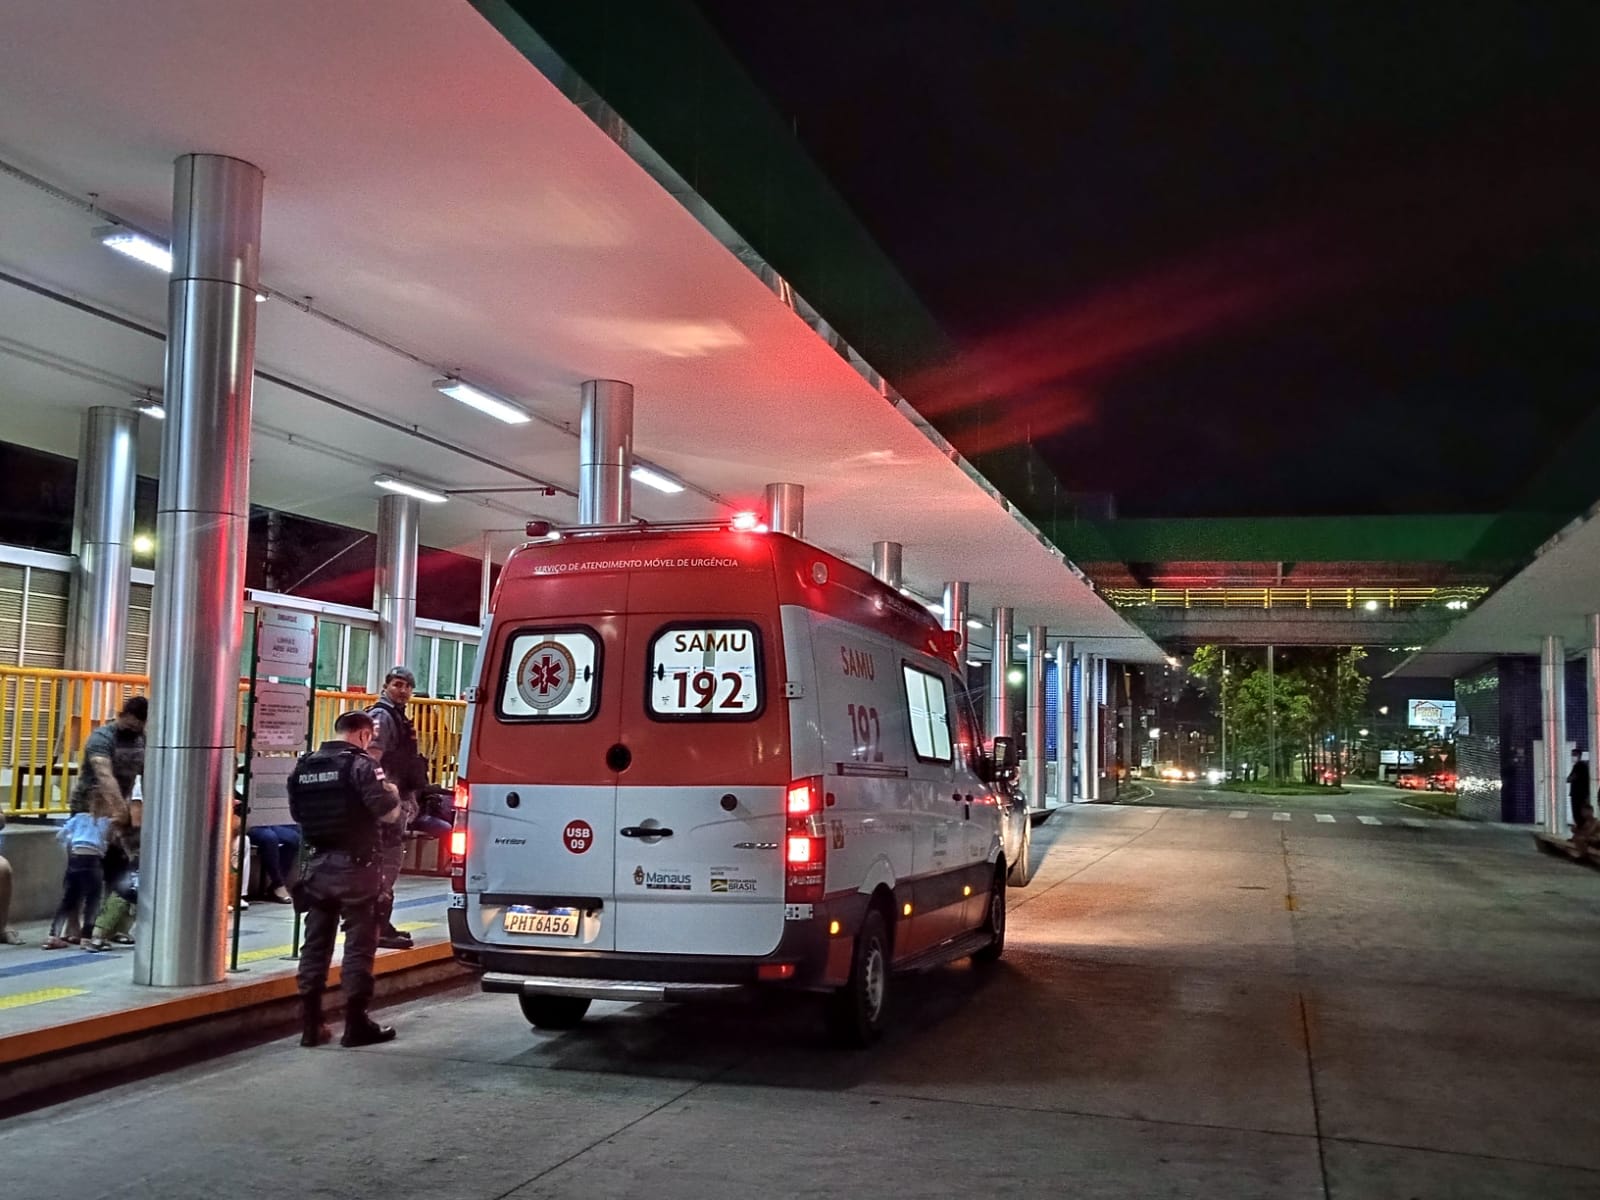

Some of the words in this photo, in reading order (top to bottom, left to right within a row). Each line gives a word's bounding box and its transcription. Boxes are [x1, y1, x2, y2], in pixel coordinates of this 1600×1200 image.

[534, 563, 567, 575] SERVIÇO
[568, 562, 579, 571] DE
[580, 559, 642, 571] ATENDIMENTO
[643, 557, 675, 568] MÓVEL
[677, 558, 689, 568] DE
[674, 633, 747, 653] SAMU
[841, 646, 875, 681] SAMU
[672, 671, 744, 709] 192
[847, 703, 884, 762] 192
[566, 827, 590, 839] USB
[570, 839, 585, 849] 09
[646, 871, 691, 885] Manaus
[728, 882, 758, 891] BRASIL
[509, 914, 570, 933] PHT6A56
